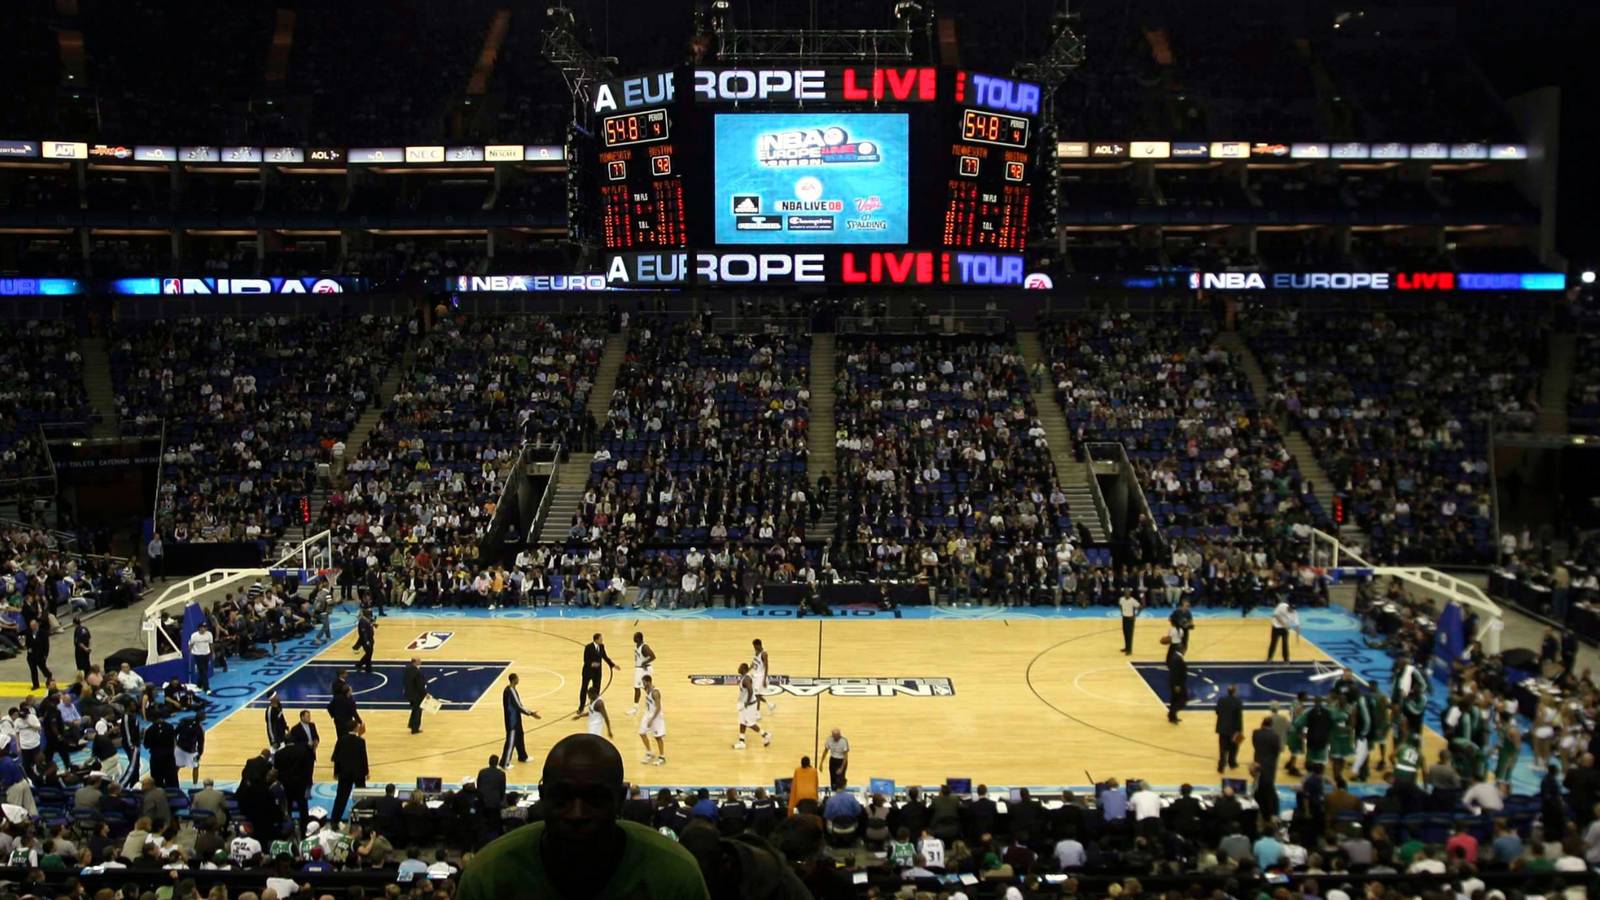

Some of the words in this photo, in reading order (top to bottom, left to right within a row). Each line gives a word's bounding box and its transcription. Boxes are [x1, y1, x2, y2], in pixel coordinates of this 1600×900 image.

[973, 74, 1039, 114] TOUR
[653, 123, 661, 135] 4
[1013, 130, 1020, 142] 4
[311, 152, 329, 160] AOL
[410, 151, 440, 159] NEC
[1094, 146, 1113, 154] AOL
[656, 158, 669, 172] 92
[1010, 164, 1022, 179] 92
[782, 201, 802, 210] NBA
[805, 201, 826, 210] LIVE
[828, 201, 842, 210] 08
[847, 220, 887, 230] SPALDING
[958, 254, 1024, 284] TOUR
[472, 276, 527, 291] NBA
[534, 276, 606, 291] EURO
[1204, 273, 1266, 289] NBA
[1273, 273, 1389, 290] EUROPE
[1396, 272, 1454, 290] LIVE
[1458, 273, 1520, 290] TOUR
[98, 458, 130, 466] CATERING
[251, 638, 327, 676] arena
[782, 684, 935, 697] NBA
[928, 850, 941, 862] 31
